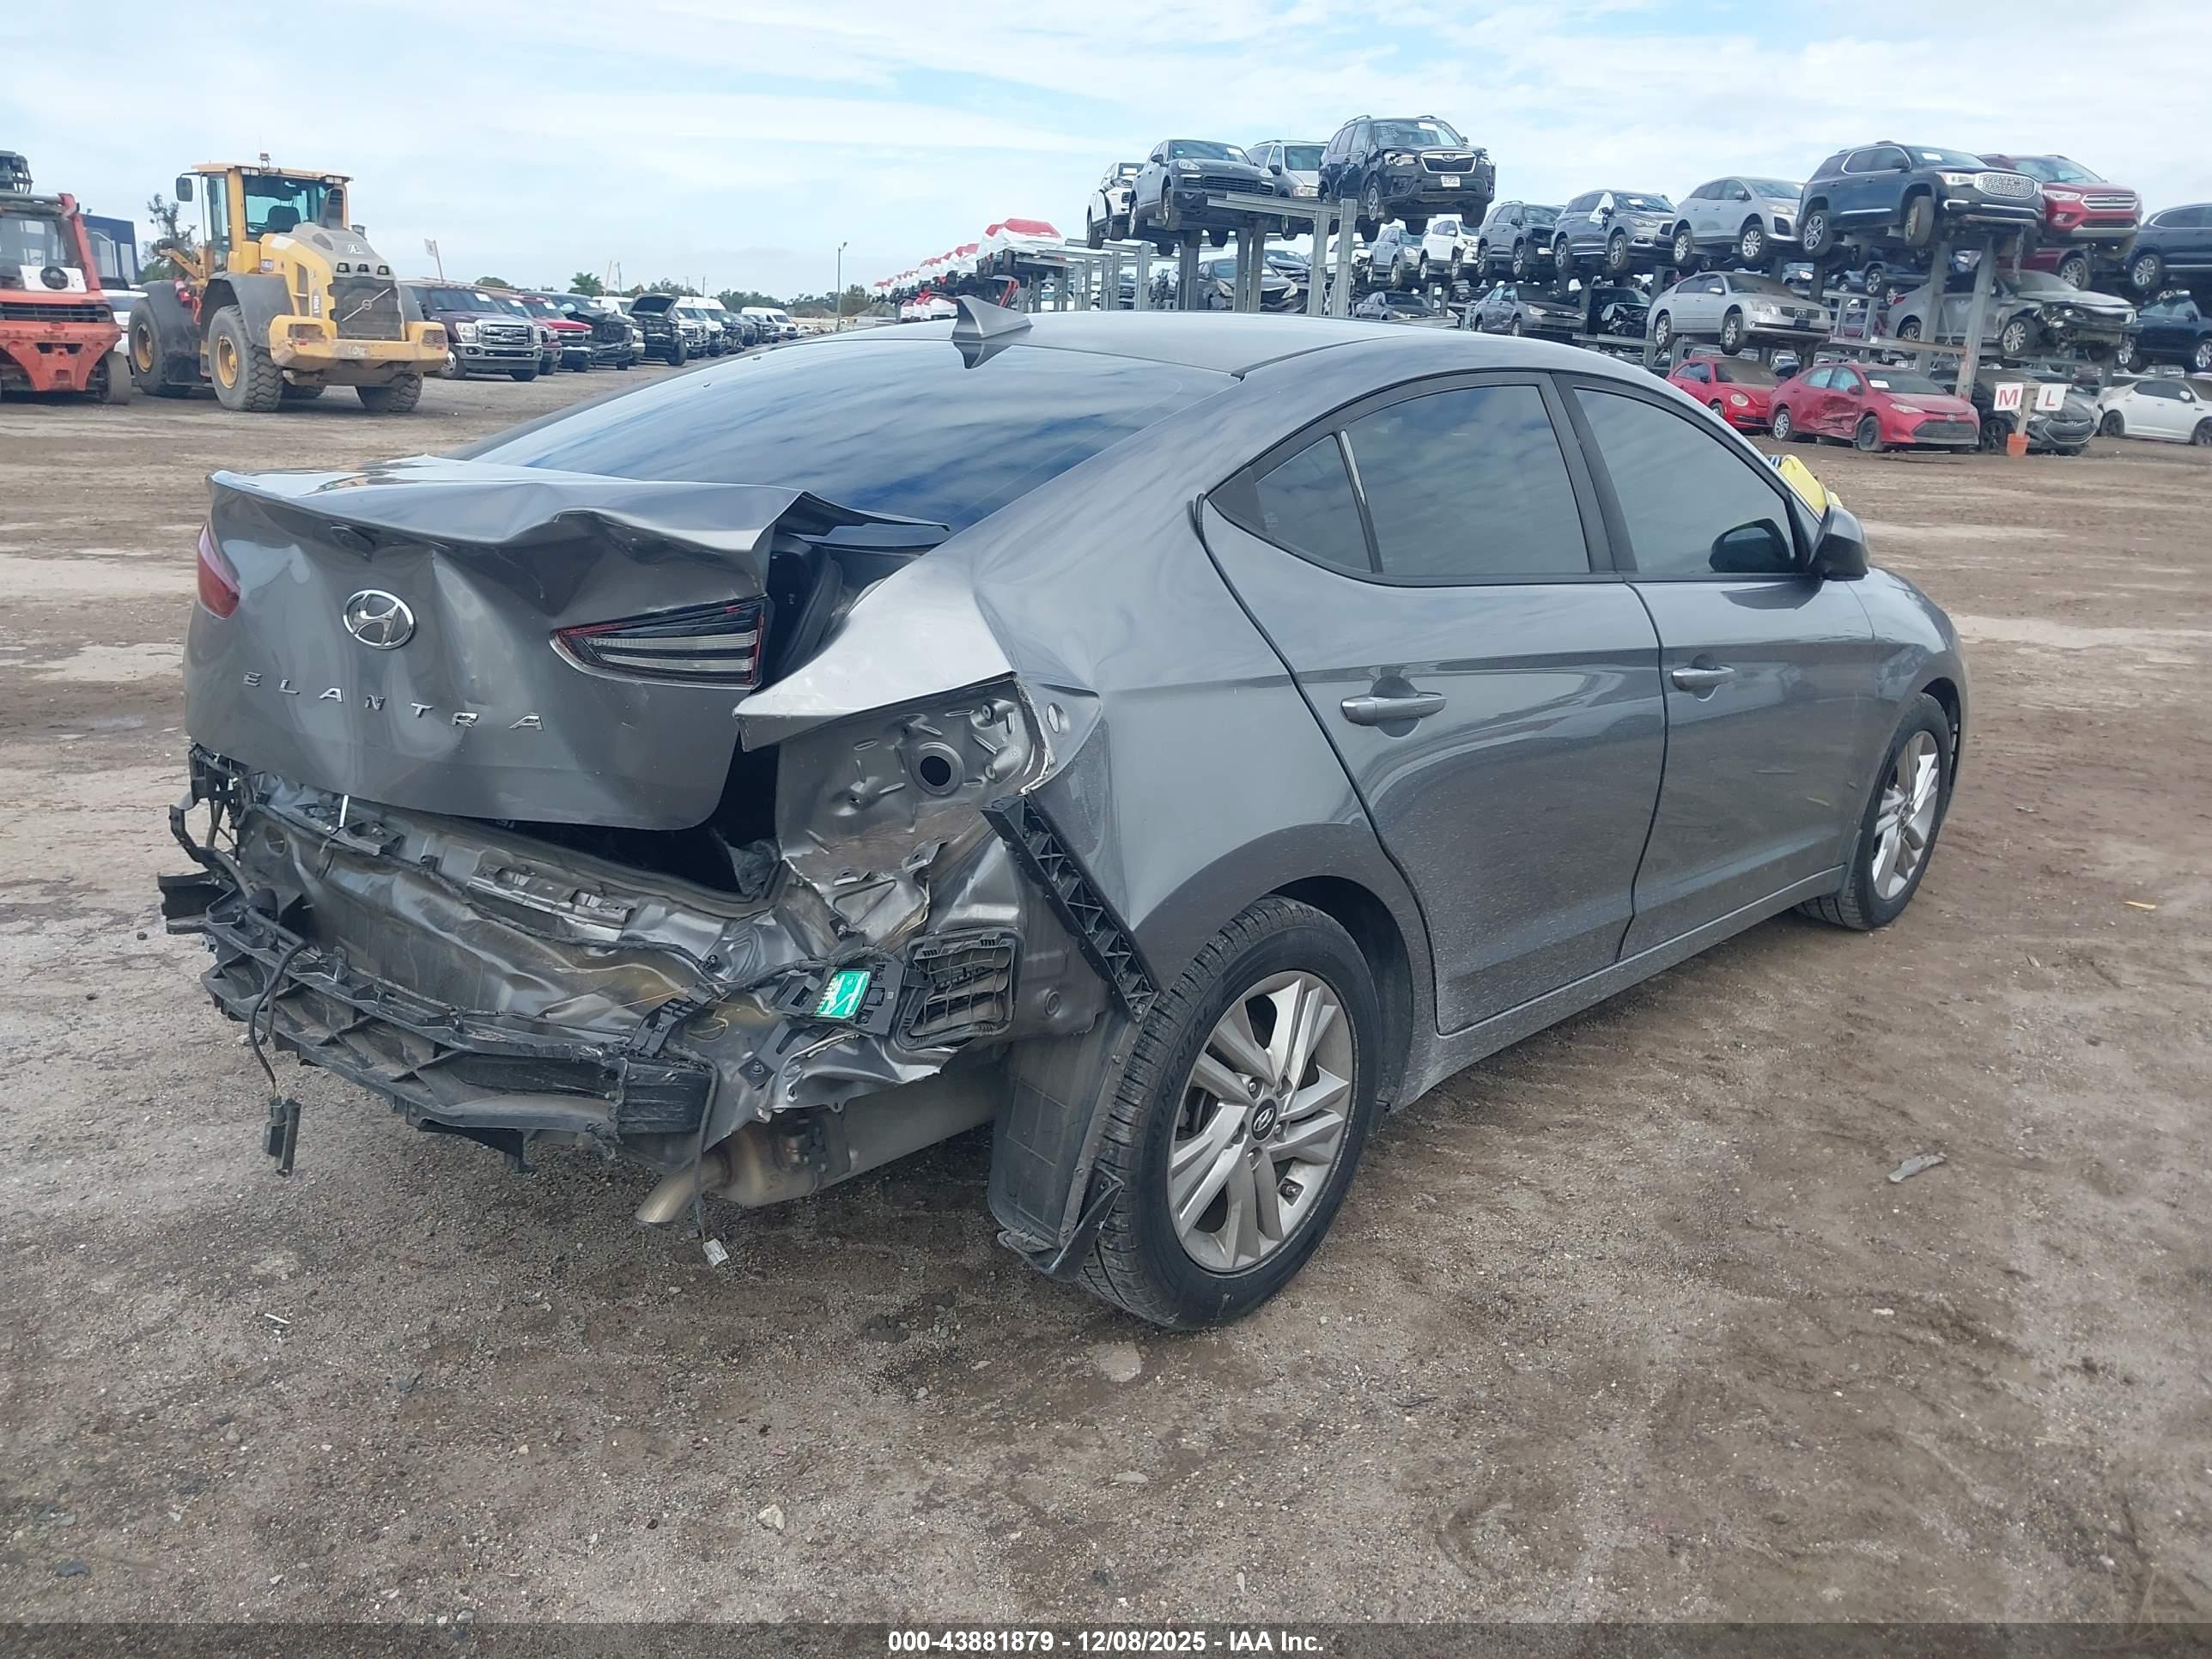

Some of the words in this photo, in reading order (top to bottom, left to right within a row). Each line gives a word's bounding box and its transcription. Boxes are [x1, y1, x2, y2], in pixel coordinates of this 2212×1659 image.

[1997, 389, 2020, 406] M
[2044, 389, 2056, 407] L
[242, 671, 545, 732] ELANTRA
